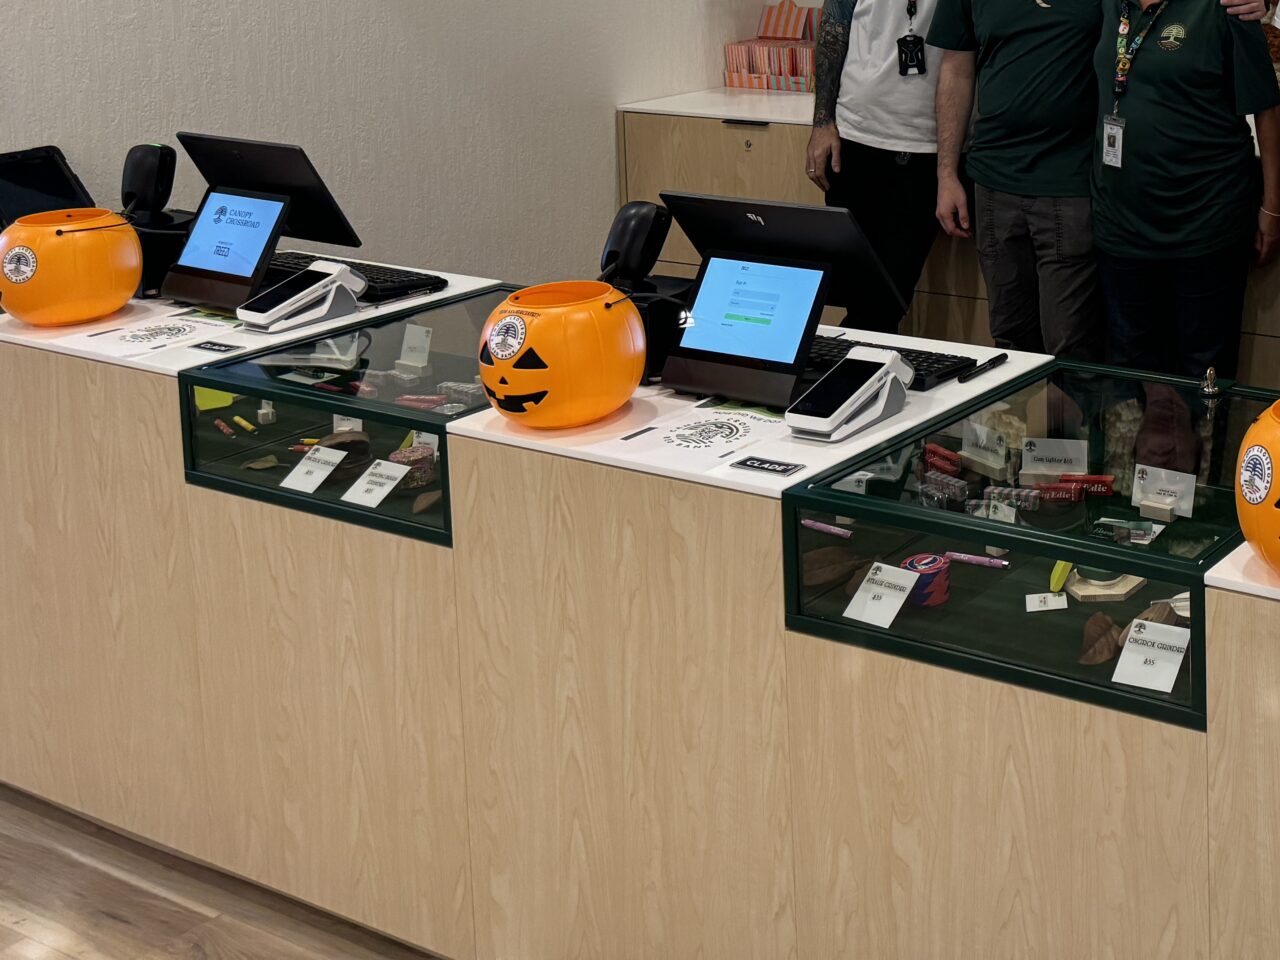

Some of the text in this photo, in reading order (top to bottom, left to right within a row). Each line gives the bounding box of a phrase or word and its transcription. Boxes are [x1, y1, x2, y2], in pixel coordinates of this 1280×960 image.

[229, 209, 254, 219] CANOPY
[226, 218, 260, 229] CROSSROAD
[1157, 643, 1186, 653] GRINDER
